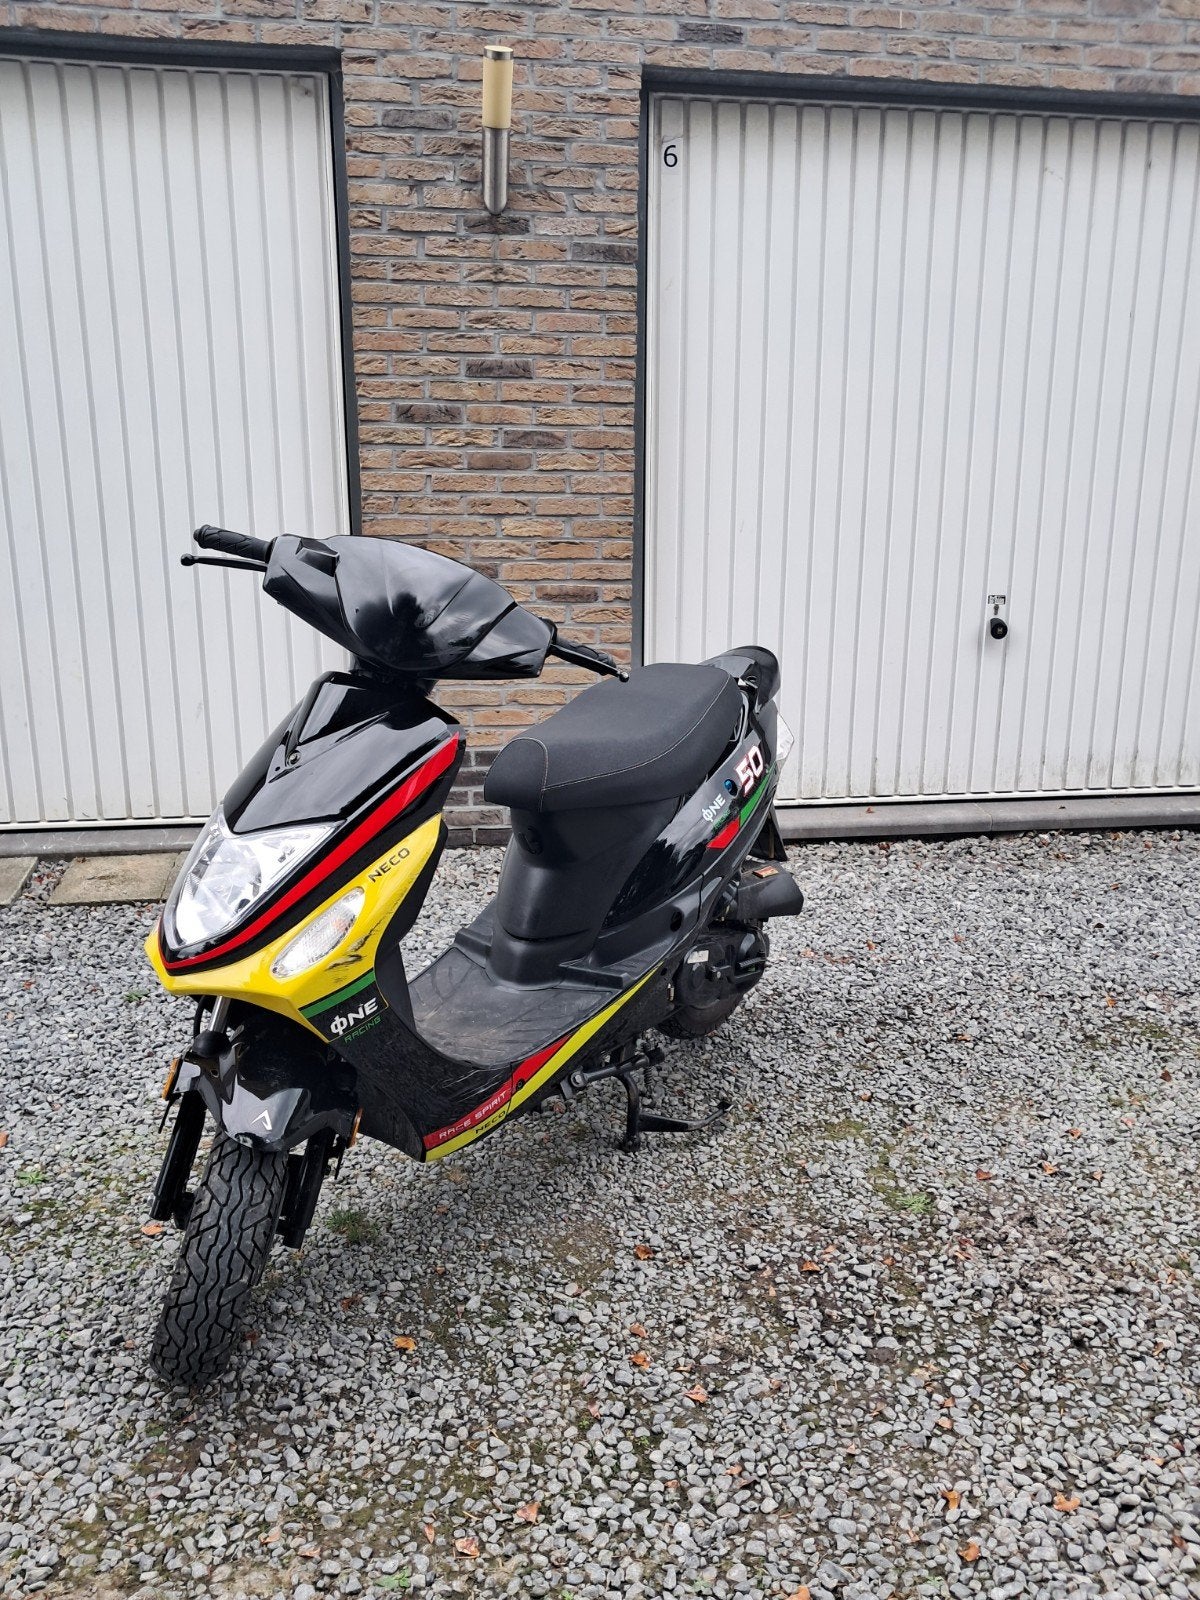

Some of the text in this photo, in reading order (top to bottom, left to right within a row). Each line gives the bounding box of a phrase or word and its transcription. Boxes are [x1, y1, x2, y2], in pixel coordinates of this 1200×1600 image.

[663, 144, 678, 168] 6
[735, 745, 764, 797] 50
[368, 847, 411, 883] NECO
[344, 1016, 382, 1049] RACING
[439, 1090, 507, 1140] RACE SPIRIT
[475, 1110, 506, 1135] NECO
